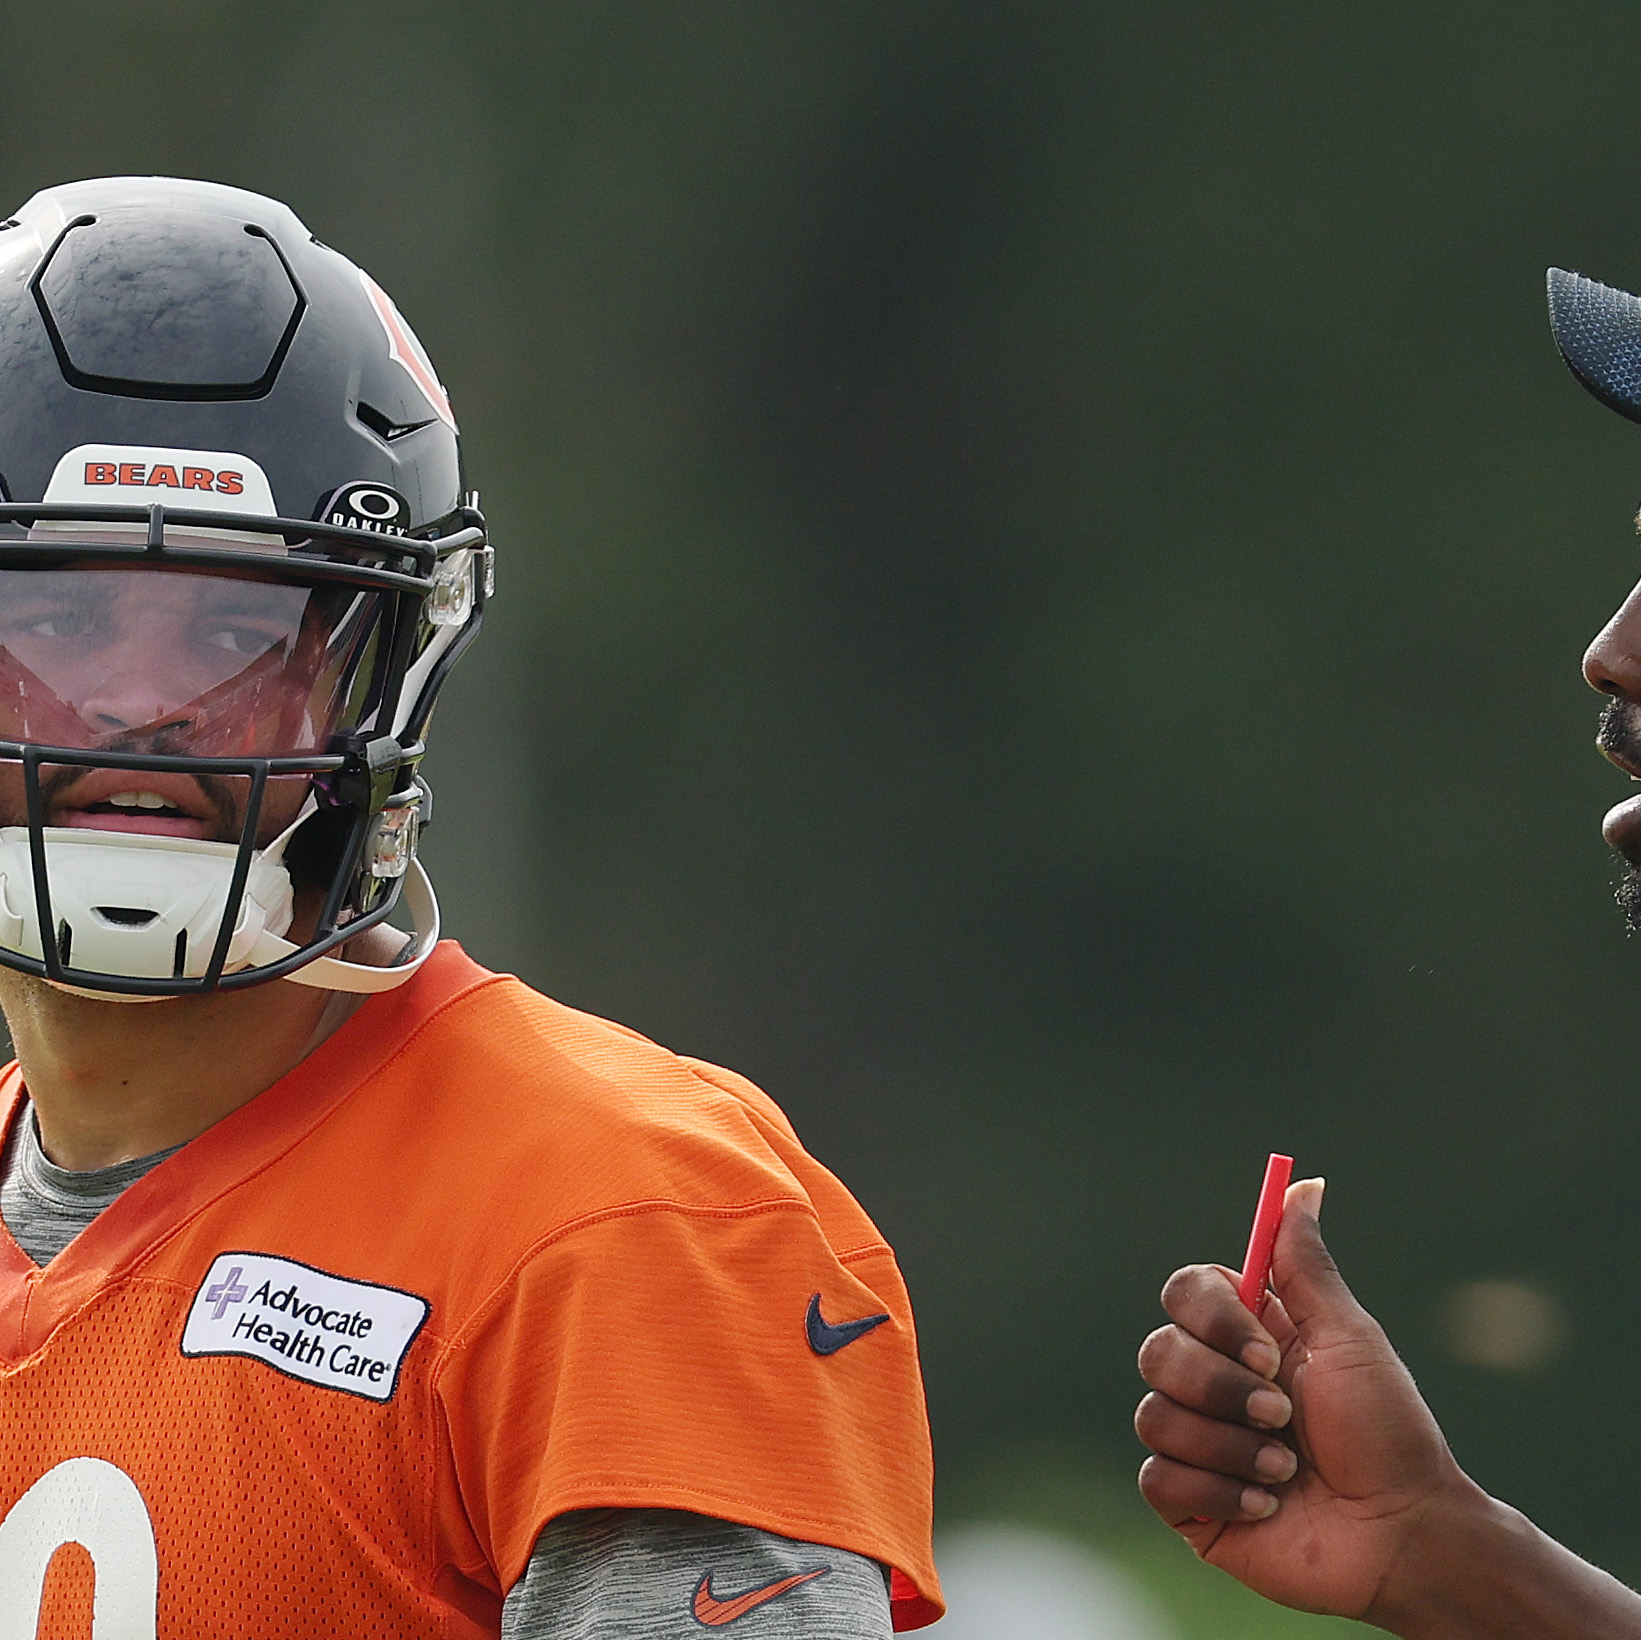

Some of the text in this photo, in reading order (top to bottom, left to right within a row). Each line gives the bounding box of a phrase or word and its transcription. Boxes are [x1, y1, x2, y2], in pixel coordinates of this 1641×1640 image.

[84, 462, 243, 495] BEARS
[332, 512, 406, 537] OAKLEY
[248, 1280, 373, 1339] Advocate
[232, 1313, 325, 1368] Health
